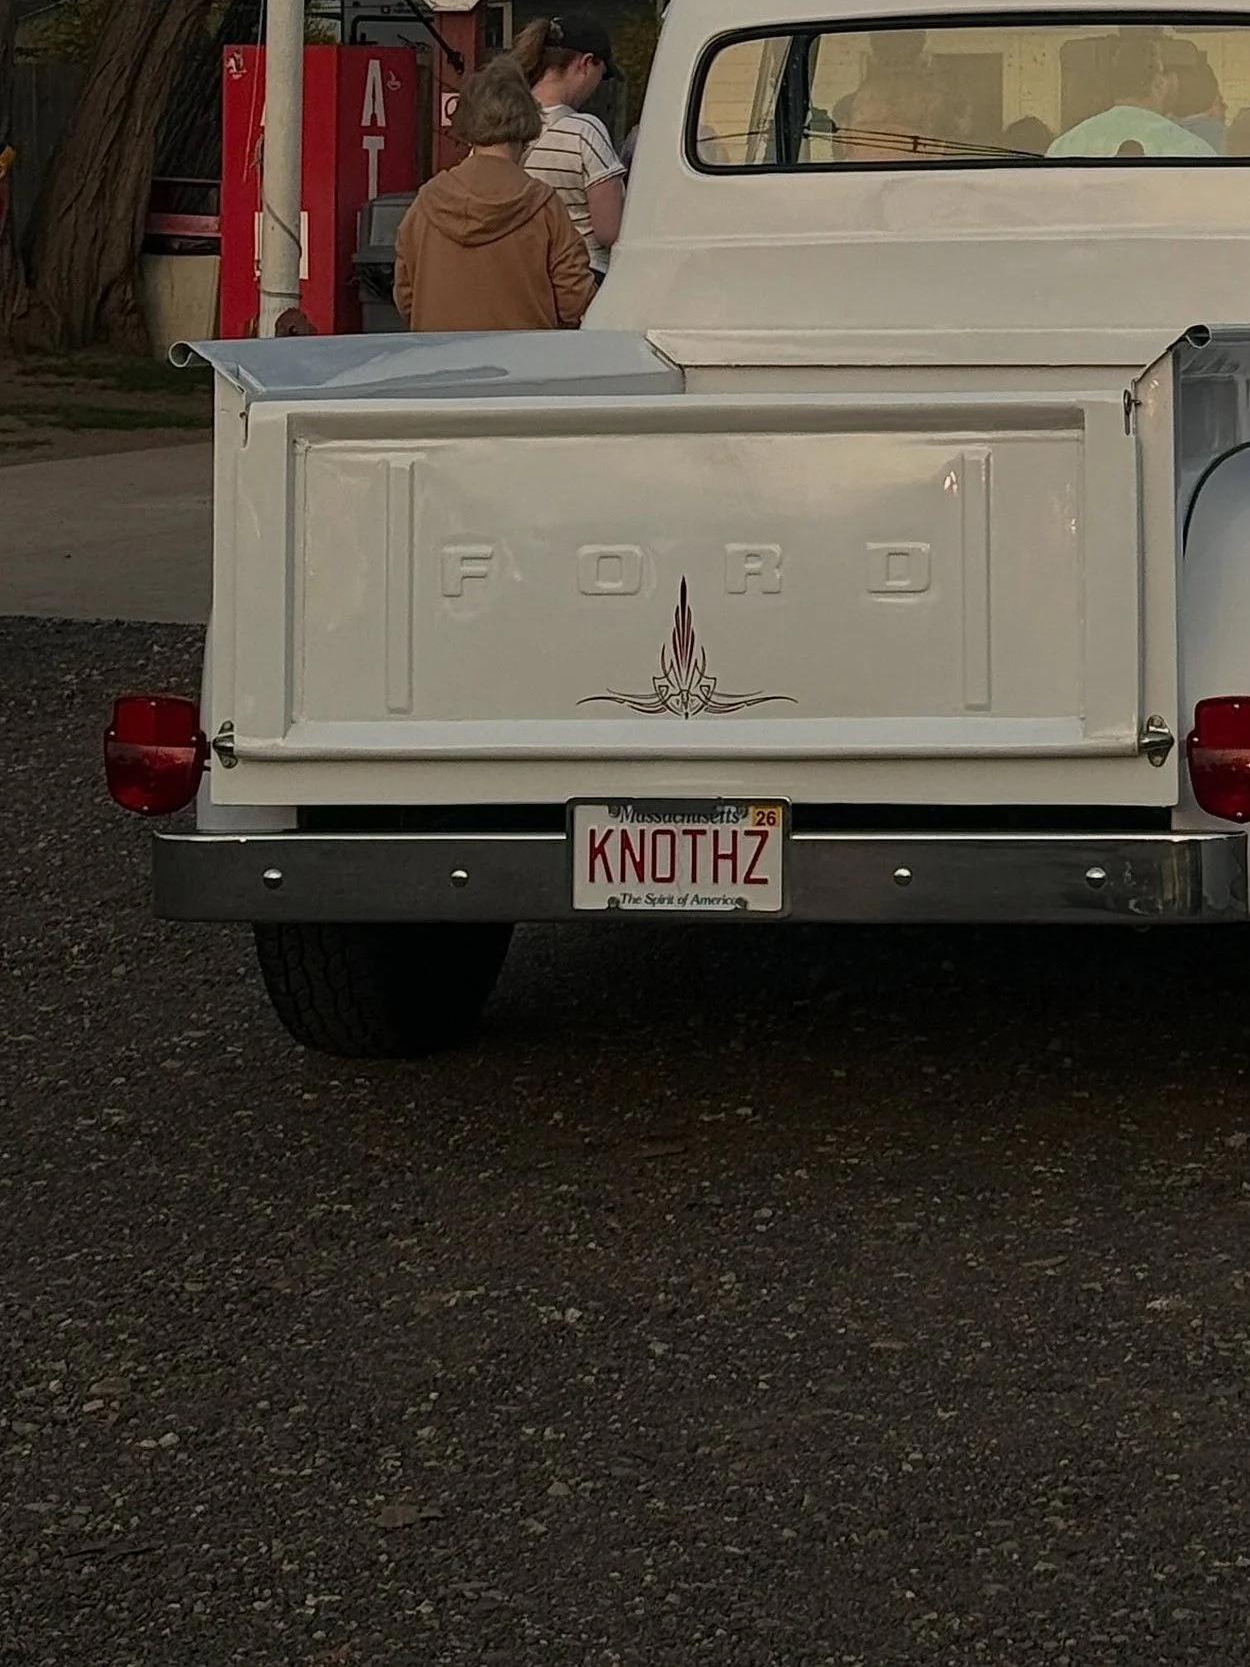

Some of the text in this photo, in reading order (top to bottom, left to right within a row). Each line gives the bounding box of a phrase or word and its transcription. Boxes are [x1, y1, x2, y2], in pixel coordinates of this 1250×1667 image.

[360, 59, 387, 202] AT
[441, 541, 932, 597] FORD
[755, 810, 776, 826] 26
[588, 828, 769, 884] KNOTHZ
[619, 892, 642, 905] The
[645, 892, 675, 907] Spirit
[677, 892, 690, 906] of
